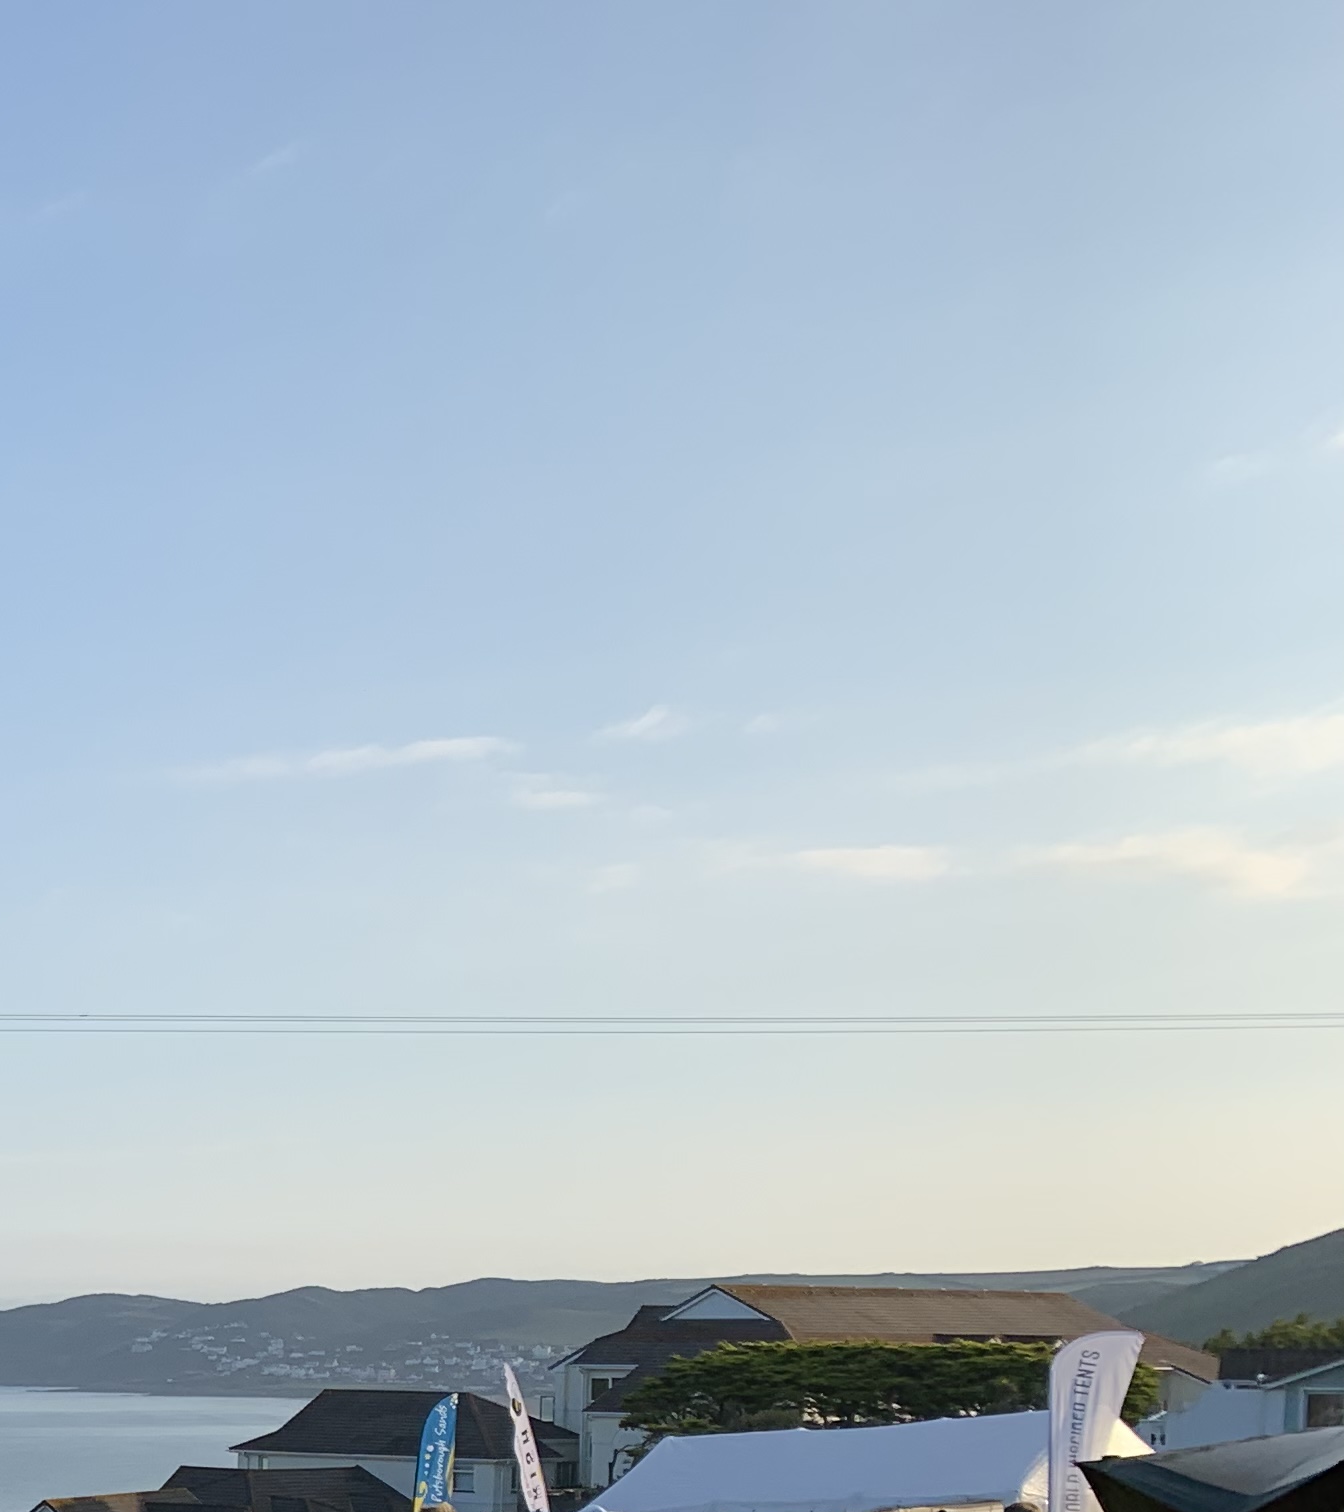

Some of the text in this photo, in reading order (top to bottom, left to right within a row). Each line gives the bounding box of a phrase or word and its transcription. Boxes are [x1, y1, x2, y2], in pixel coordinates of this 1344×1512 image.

[1073, 1349, 1101, 1397] TENTS
[430, 1404, 451, 1503] Putsborough Sands
